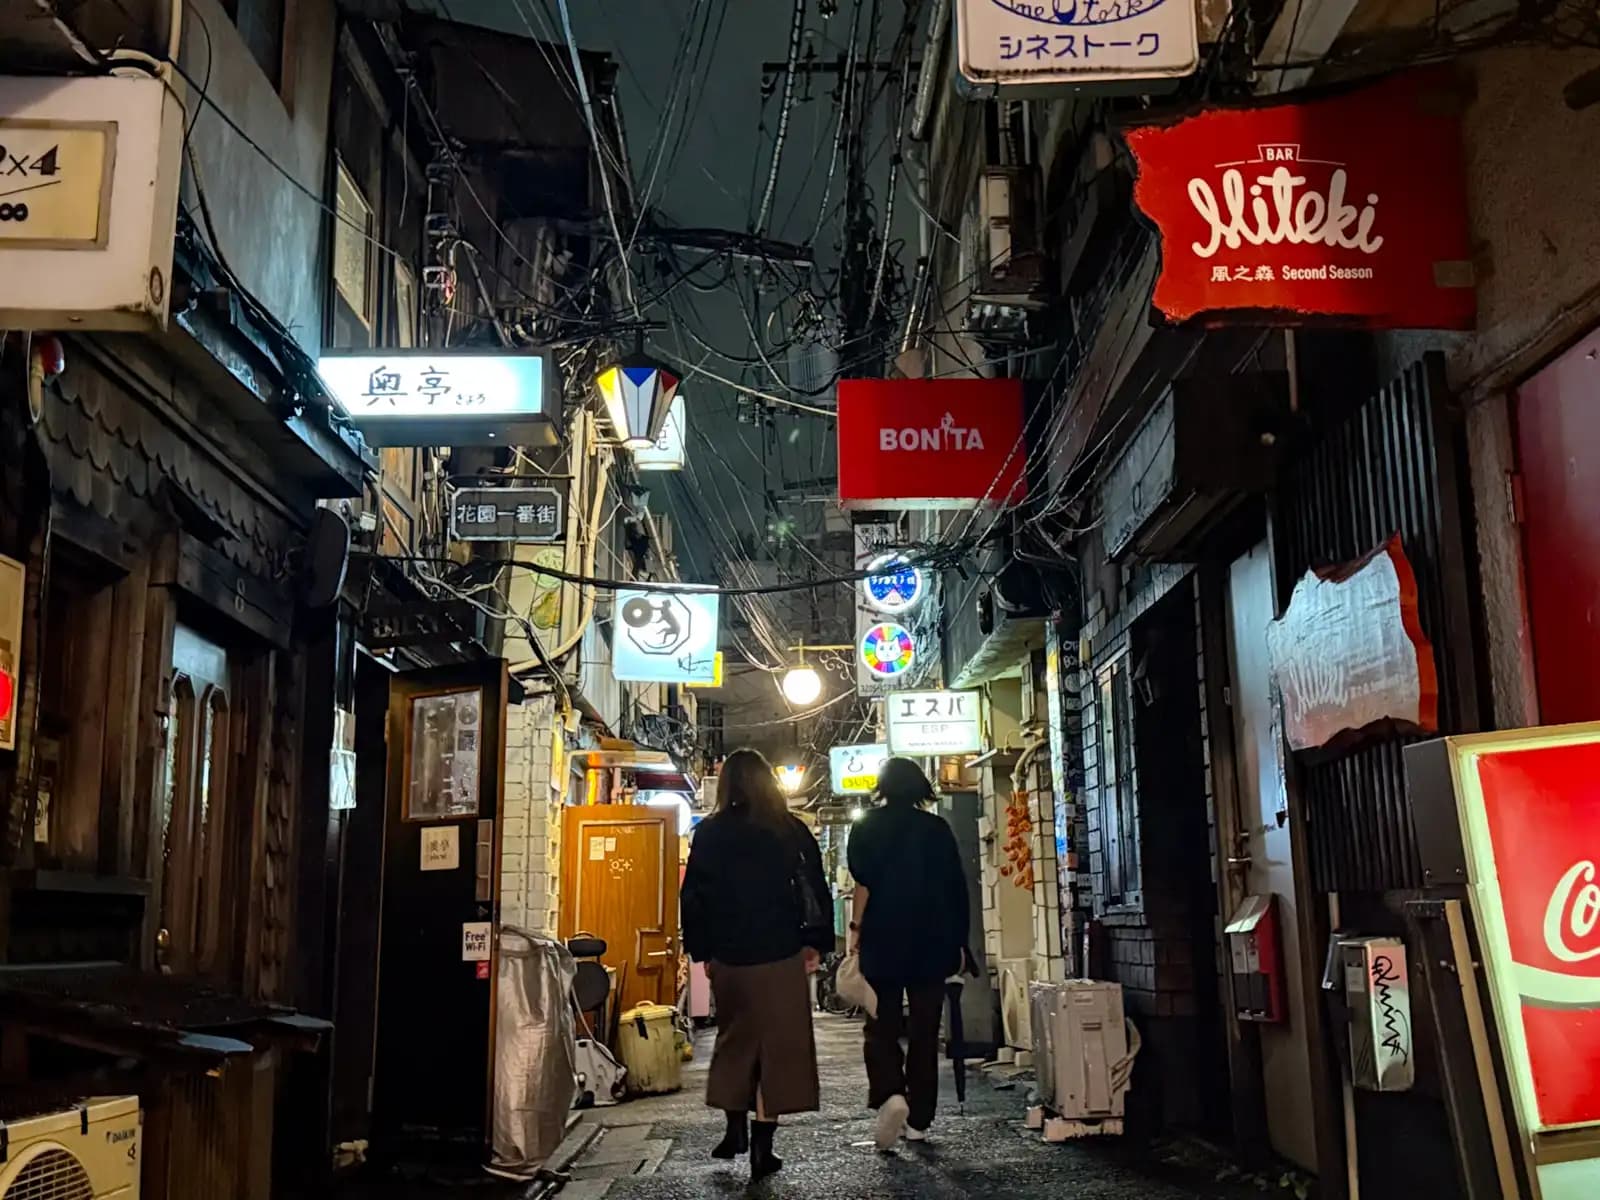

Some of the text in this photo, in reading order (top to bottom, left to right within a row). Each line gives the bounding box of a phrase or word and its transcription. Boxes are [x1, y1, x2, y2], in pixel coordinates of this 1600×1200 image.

[999, 33, 1160, 60] シネストーク
[1266, 148, 1294, 161] BAR
[1210, 264, 1373, 282] 風之森 Second Season
[457, 504, 556, 524] 花園一番街
[900, 695, 966, 717] エスパ
[465, 931, 486, 942] Free
